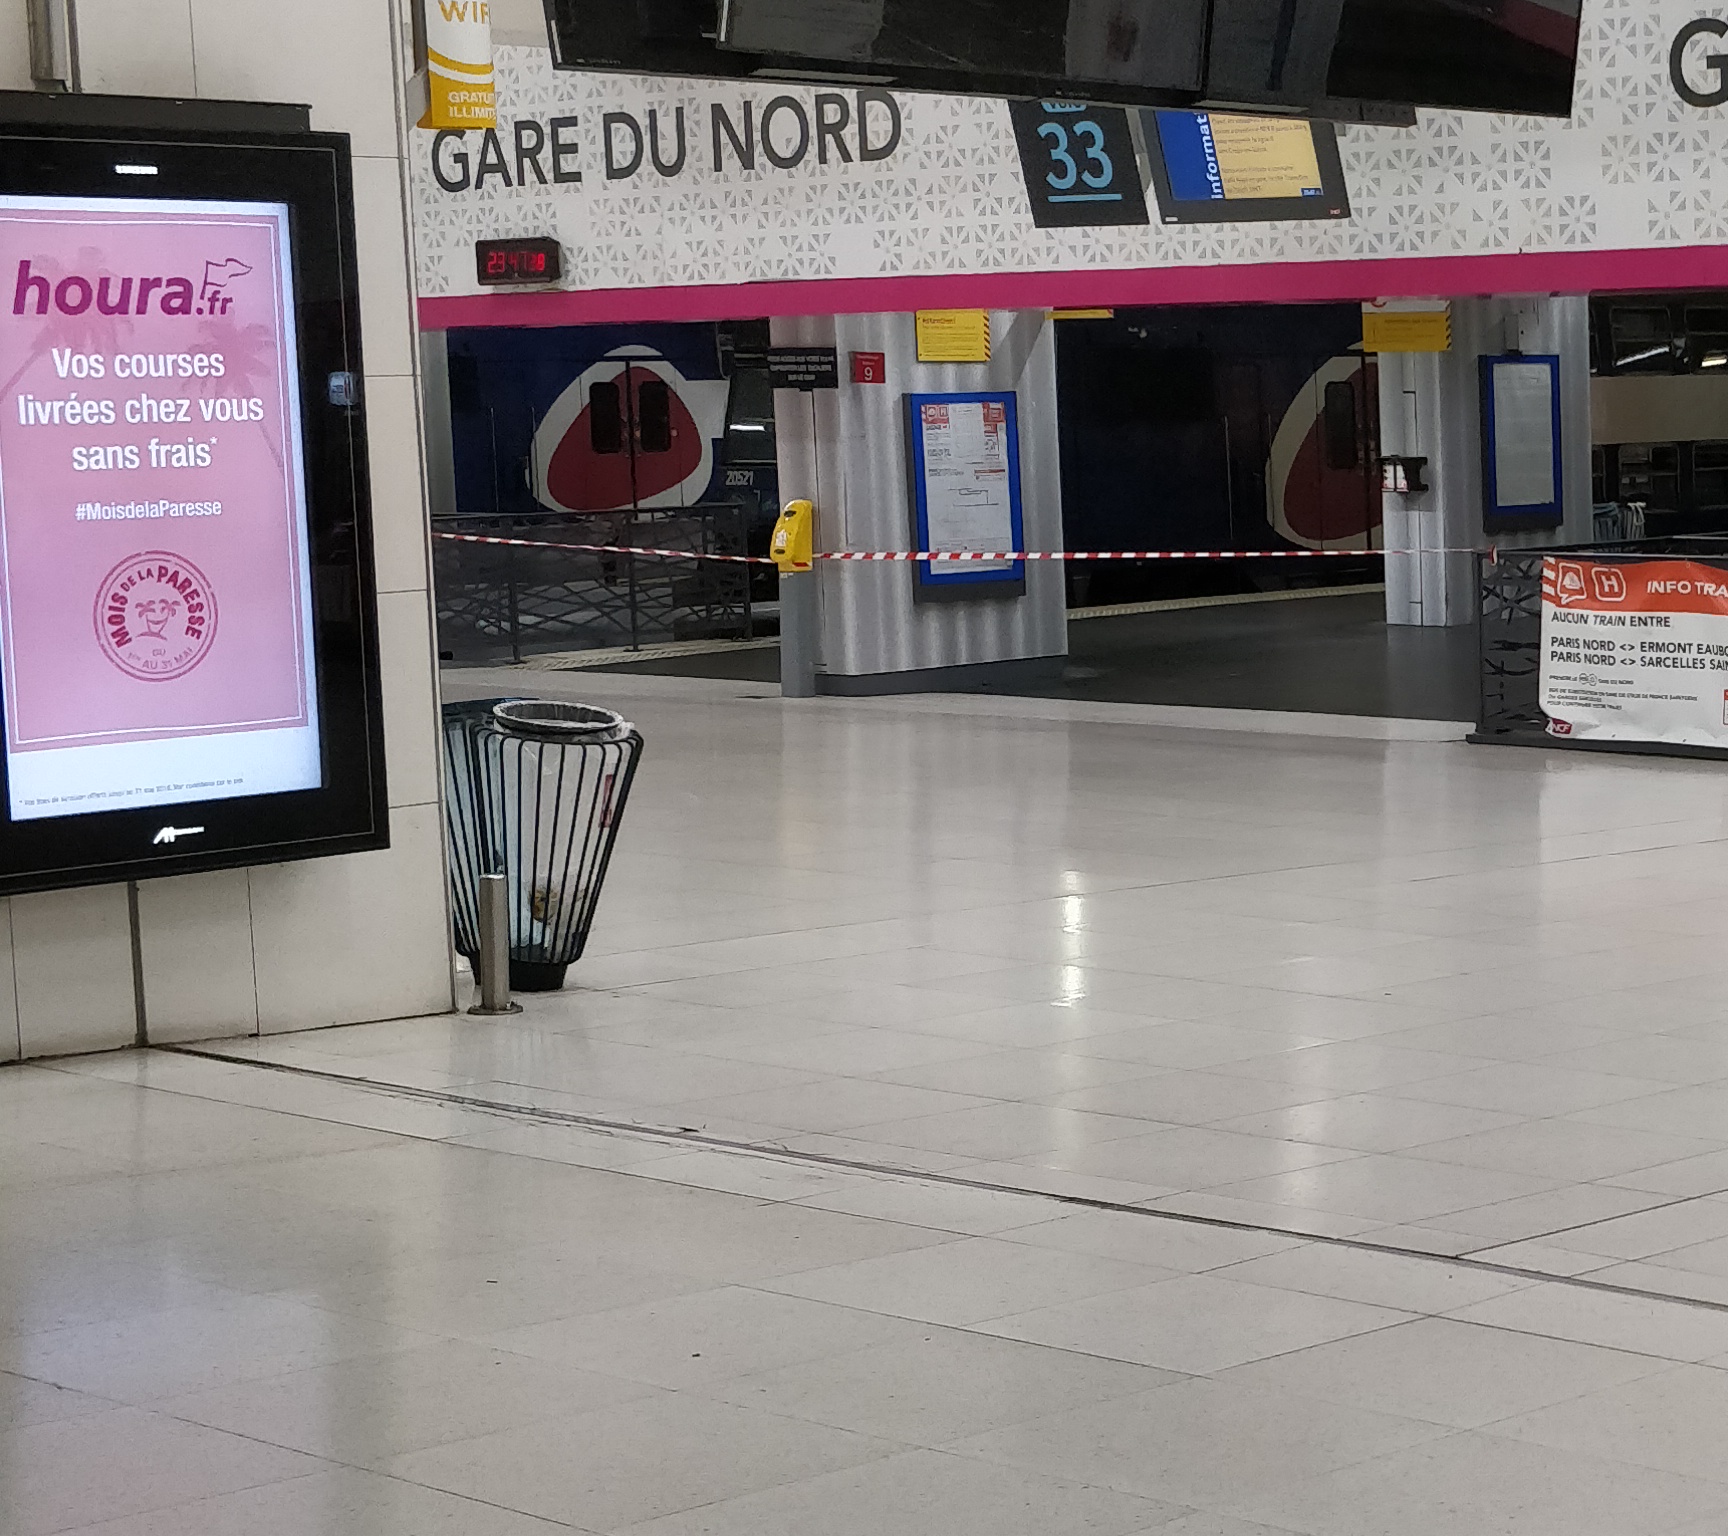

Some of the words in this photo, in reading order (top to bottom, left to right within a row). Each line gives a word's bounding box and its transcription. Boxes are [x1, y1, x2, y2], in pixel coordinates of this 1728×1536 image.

[431, 115, 582, 192] GARE
[603, 106, 687, 181] DU
[711, 90, 901, 173] NORD
[1037, 120, 1113, 190] 33
[52, 347, 106, 379] Vos
[114, 352, 226, 378] courses
[864, 366, 873, 381] 9
[17, 392, 116, 425] livrées
[125, 393, 192, 423] chez
[198, 397, 265, 422] vous
[72, 444, 141, 471] sans
[725, 470, 754, 486] 20521
[75, 499, 223, 521] #MoisdelaParesse
[1600, 574, 1620, 594] H
[1646, 580, 1692, 594] INFO
[107, 591, 133, 649] MOIS
[120, 574, 137, 593] DE
[137, 567, 155, 582] LA
[156, 564, 206, 641] PARESSE
[1551, 611, 1589, 625] AUCUN
[1592, 614, 1626, 627] TRAIN
[1629, 615, 1671, 628] ENTRE
[1551, 636, 1580, 649] PARIS
[1582, 638, 1616, 652] NORD
[1640, 641, 1693, 655] ERMONT
[1550, 650, 1581, 663] PARIS
[1583, 653, 1616, 666] NORD
[1640, 655, 1706, 670] SARCELLES
